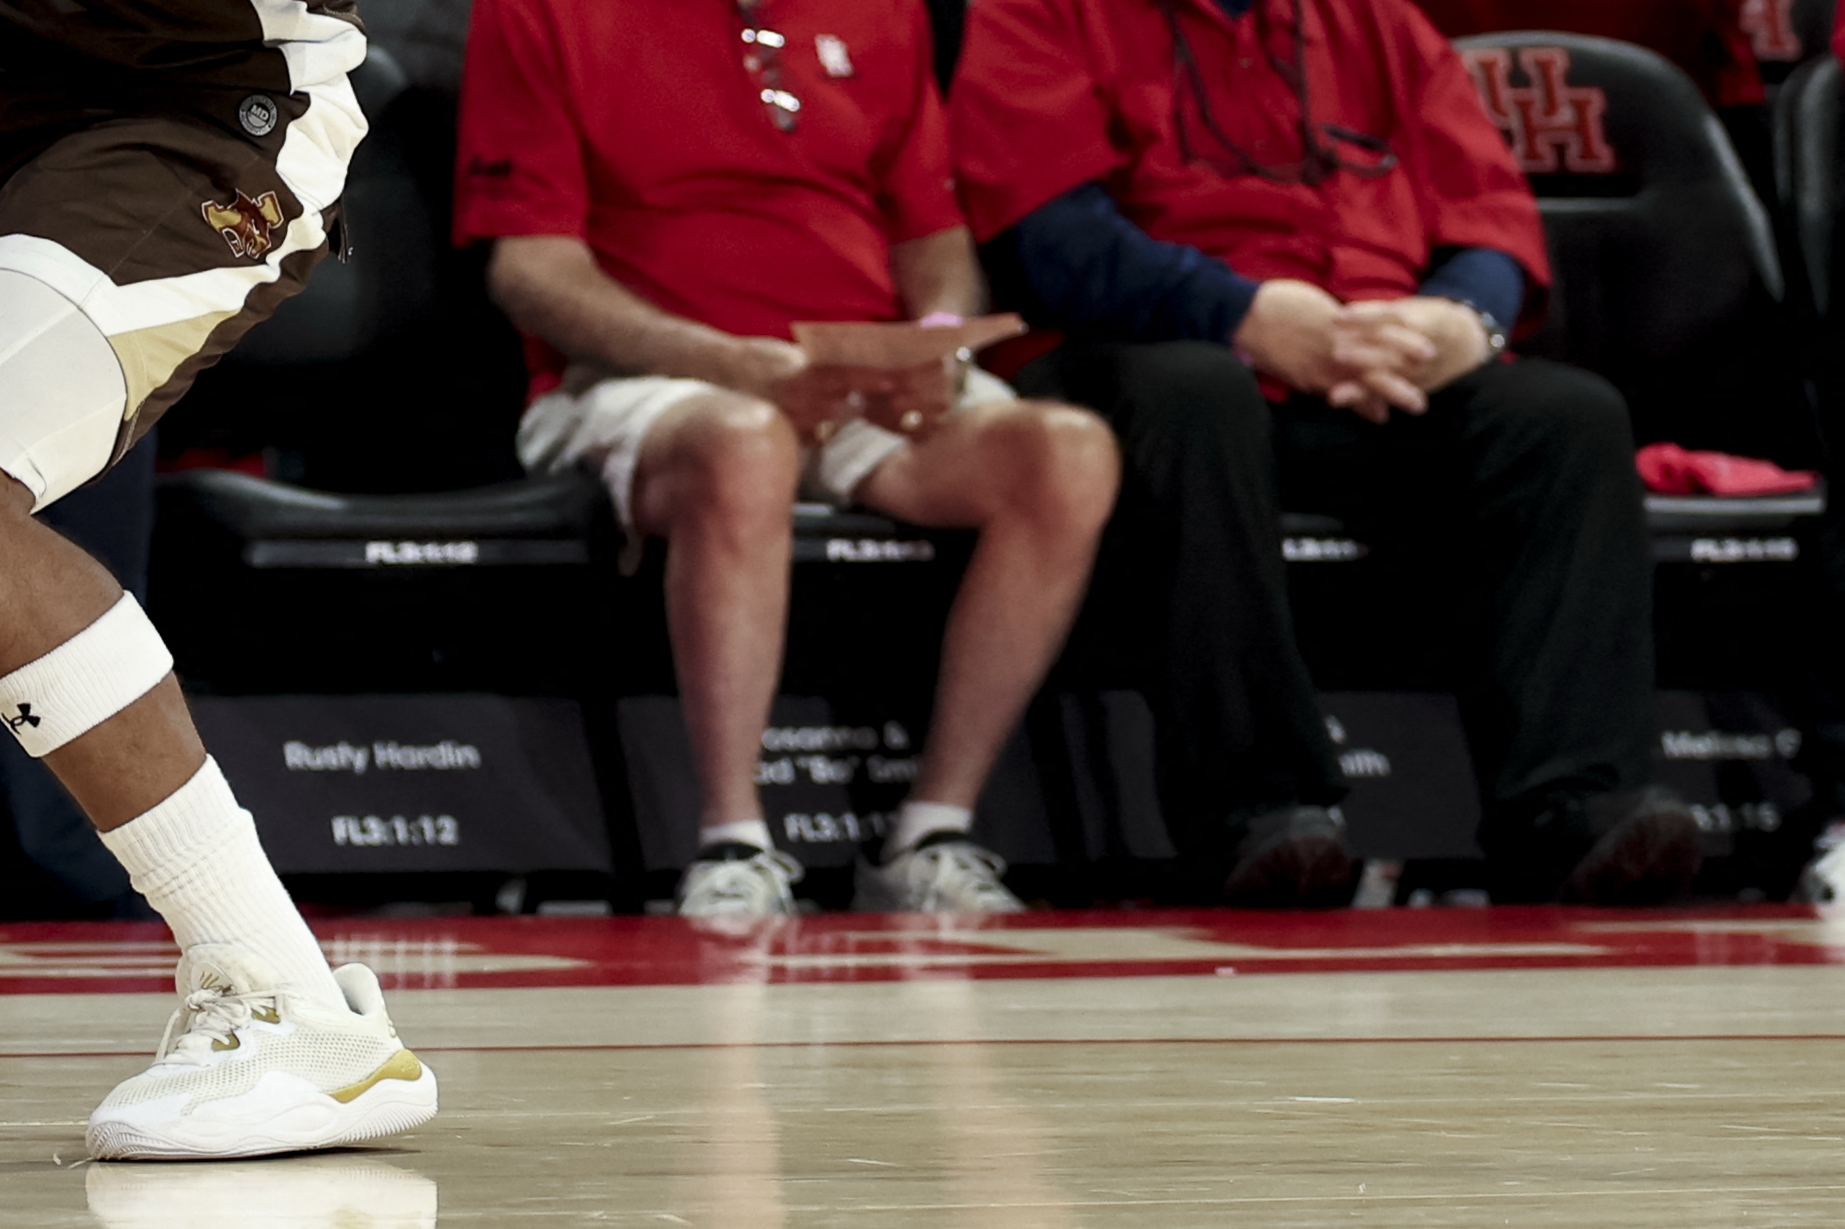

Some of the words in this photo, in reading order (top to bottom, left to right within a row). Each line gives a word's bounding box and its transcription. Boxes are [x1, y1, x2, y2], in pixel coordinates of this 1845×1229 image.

[283, 740, 369, 773] Rusty
[374, 740, 482, 770] Hardin
[331, 814, 460, 845] FL3:1:12
